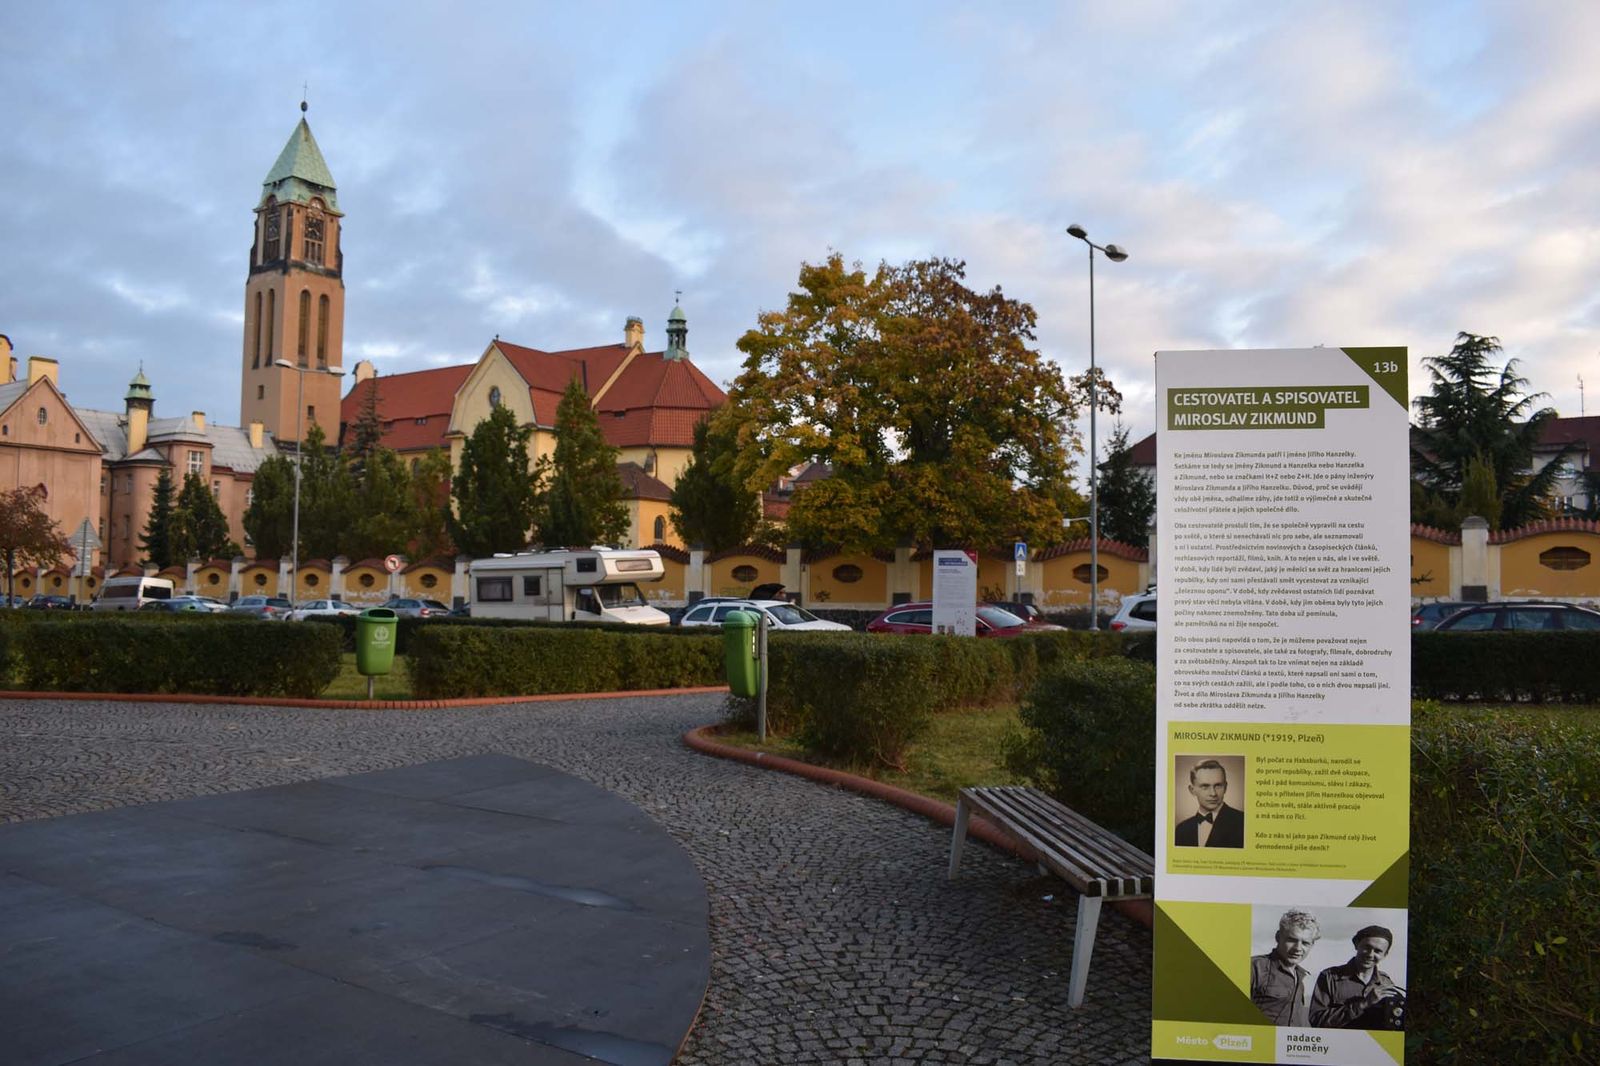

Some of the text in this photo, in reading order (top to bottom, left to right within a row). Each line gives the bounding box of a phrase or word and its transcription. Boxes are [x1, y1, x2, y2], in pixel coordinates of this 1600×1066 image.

[1374, 362, 1398, 373] 13b
[1174, 391, 1360, 406] CESTOVATEL A SPISOVATEL
[1174, 412, 1317, 426] MIROSLAV ZIKMUND
[1174, 732, 1218, 740] MIROSLAV
[1220, 732, 1260, 741] ZIKMUND
[1298, 733, 1324, 743] Plzeň)
[1176, 1036, 1248, 1048] Město Plzeň
[1287, 1034, 1321, 1042] nadace
[1287, 1044, 1329, 1054] proměny
